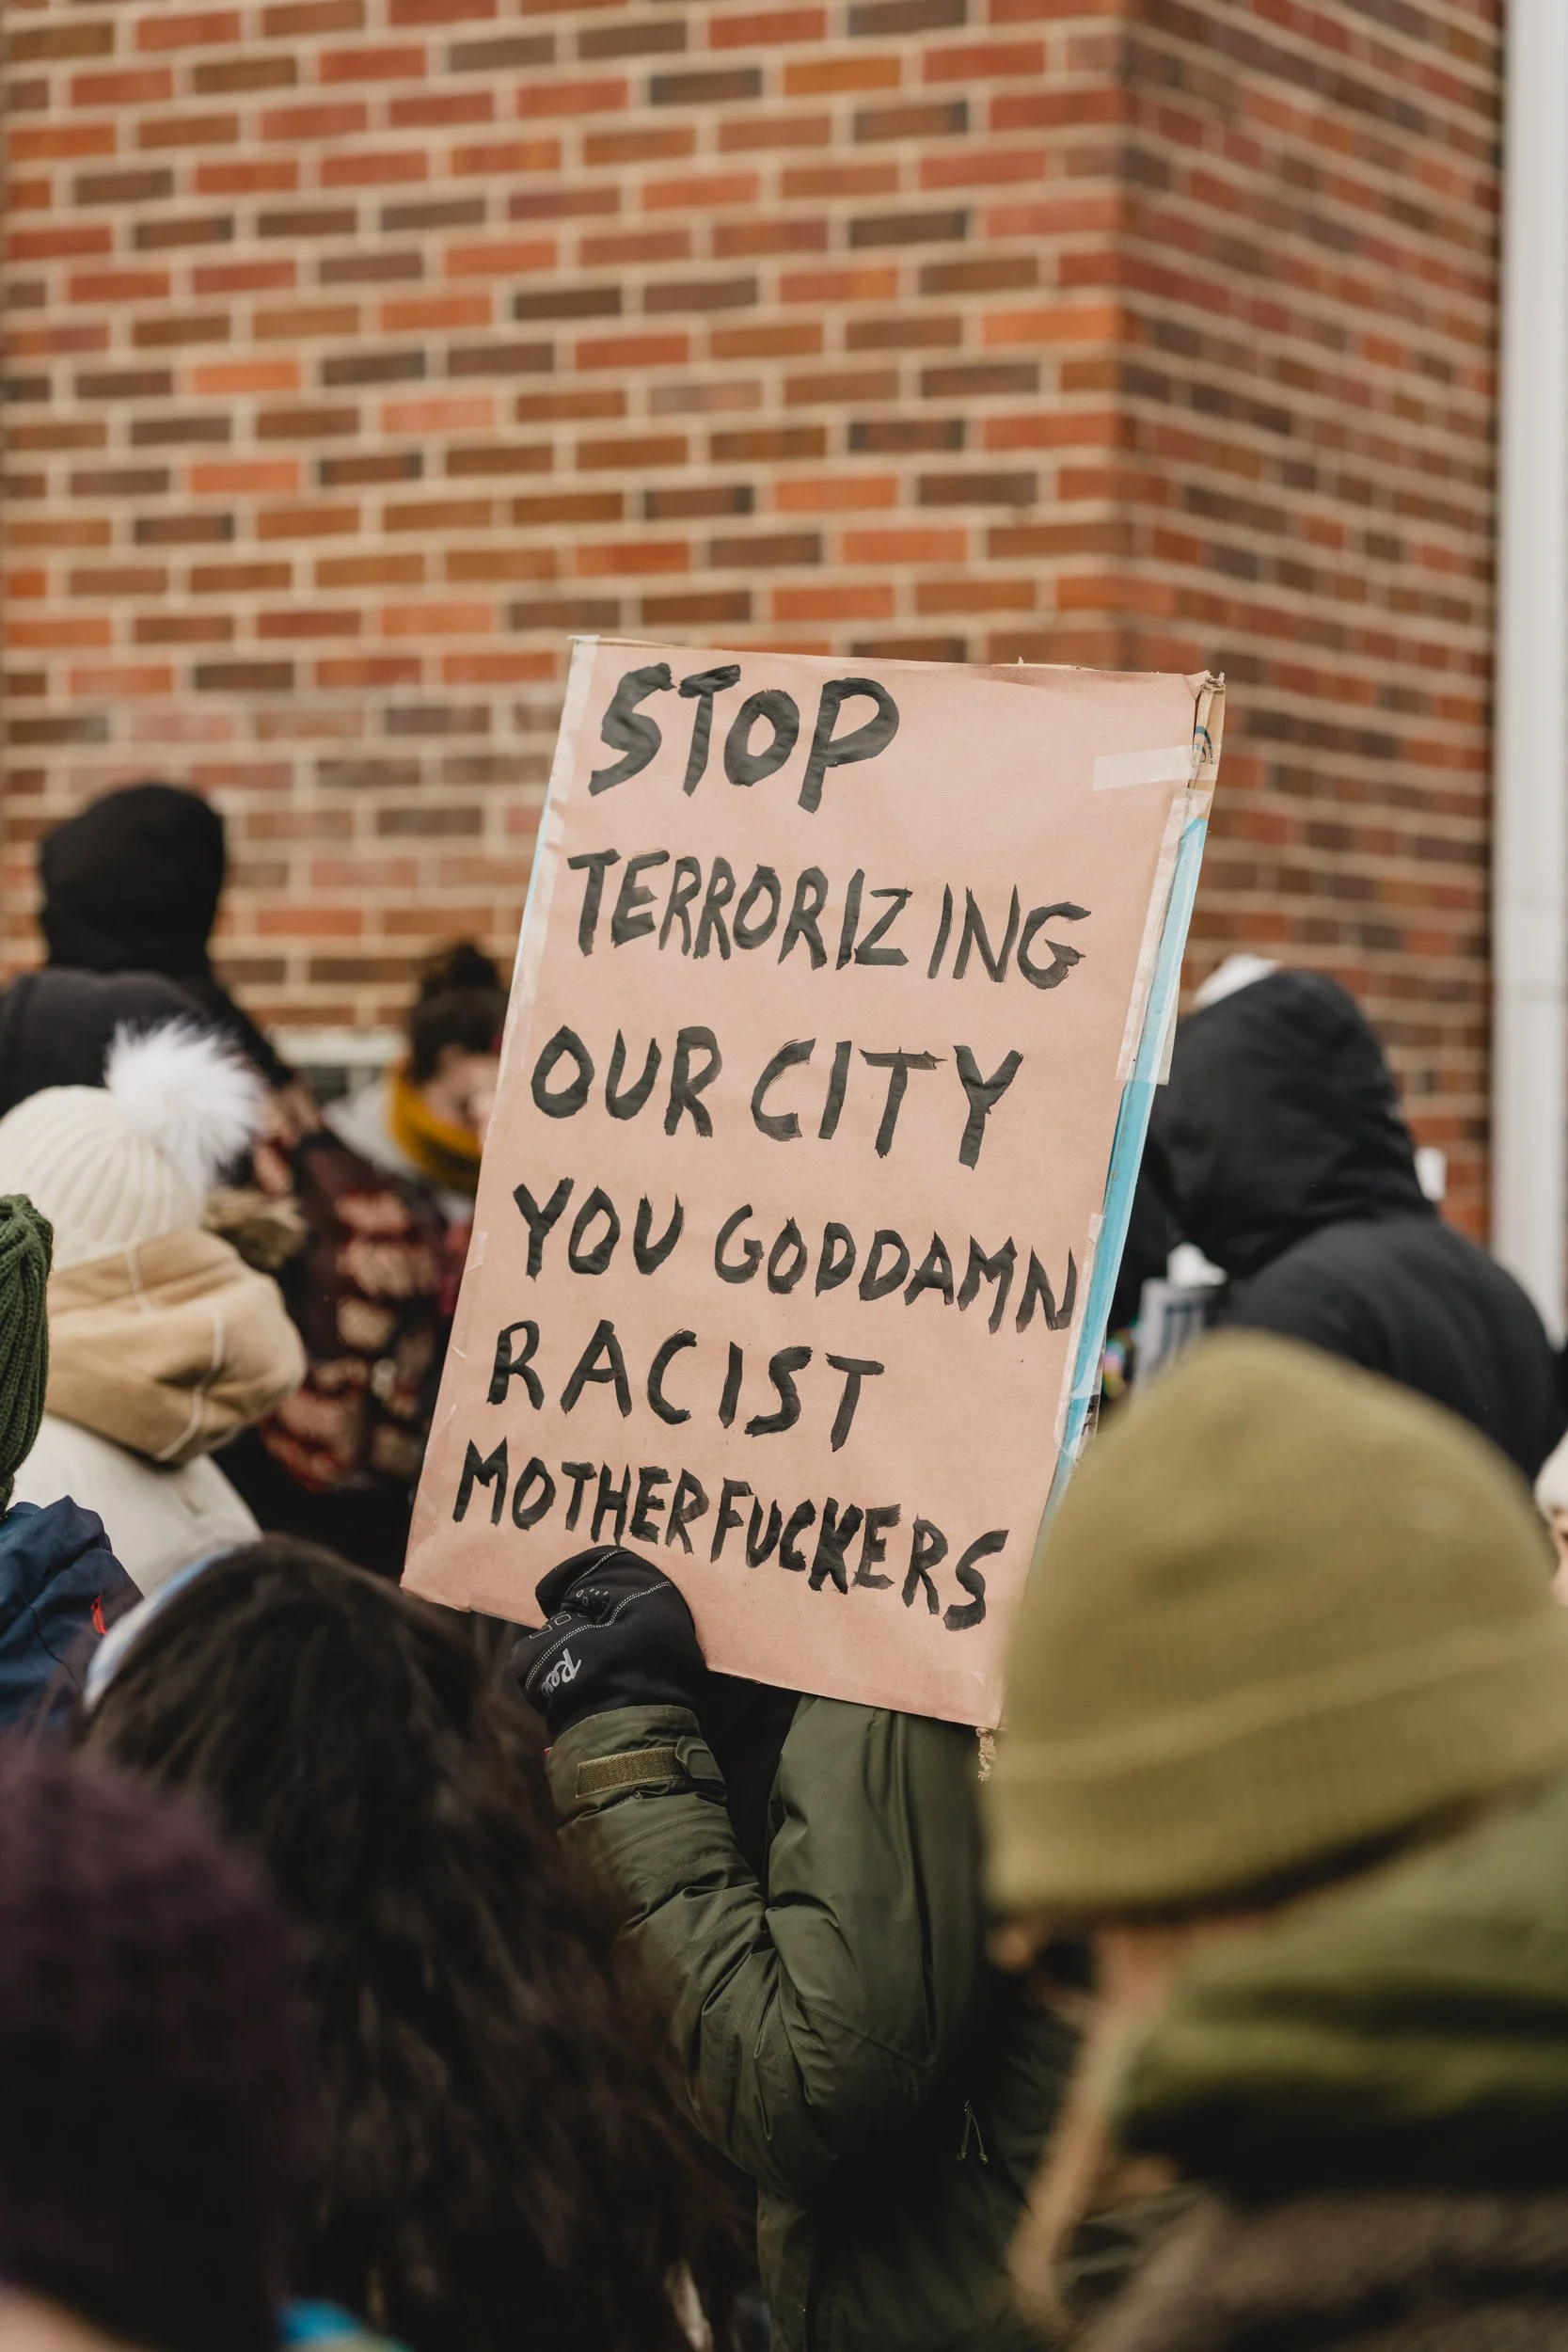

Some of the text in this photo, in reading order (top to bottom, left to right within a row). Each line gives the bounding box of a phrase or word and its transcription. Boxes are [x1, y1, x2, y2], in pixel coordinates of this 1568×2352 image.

[588, 661, 900, 815] STOP
[566, 848, 1093, 992] TERRORIZING
[531, 1025, 1024, 1172] OUR CITY
[512, 1176, 1079, 1335] YOU GODDAMN
[485, 1319, 886, 1453] RACIST
[451, 1436, 1011, 1632] MOTHERFUCKERS
